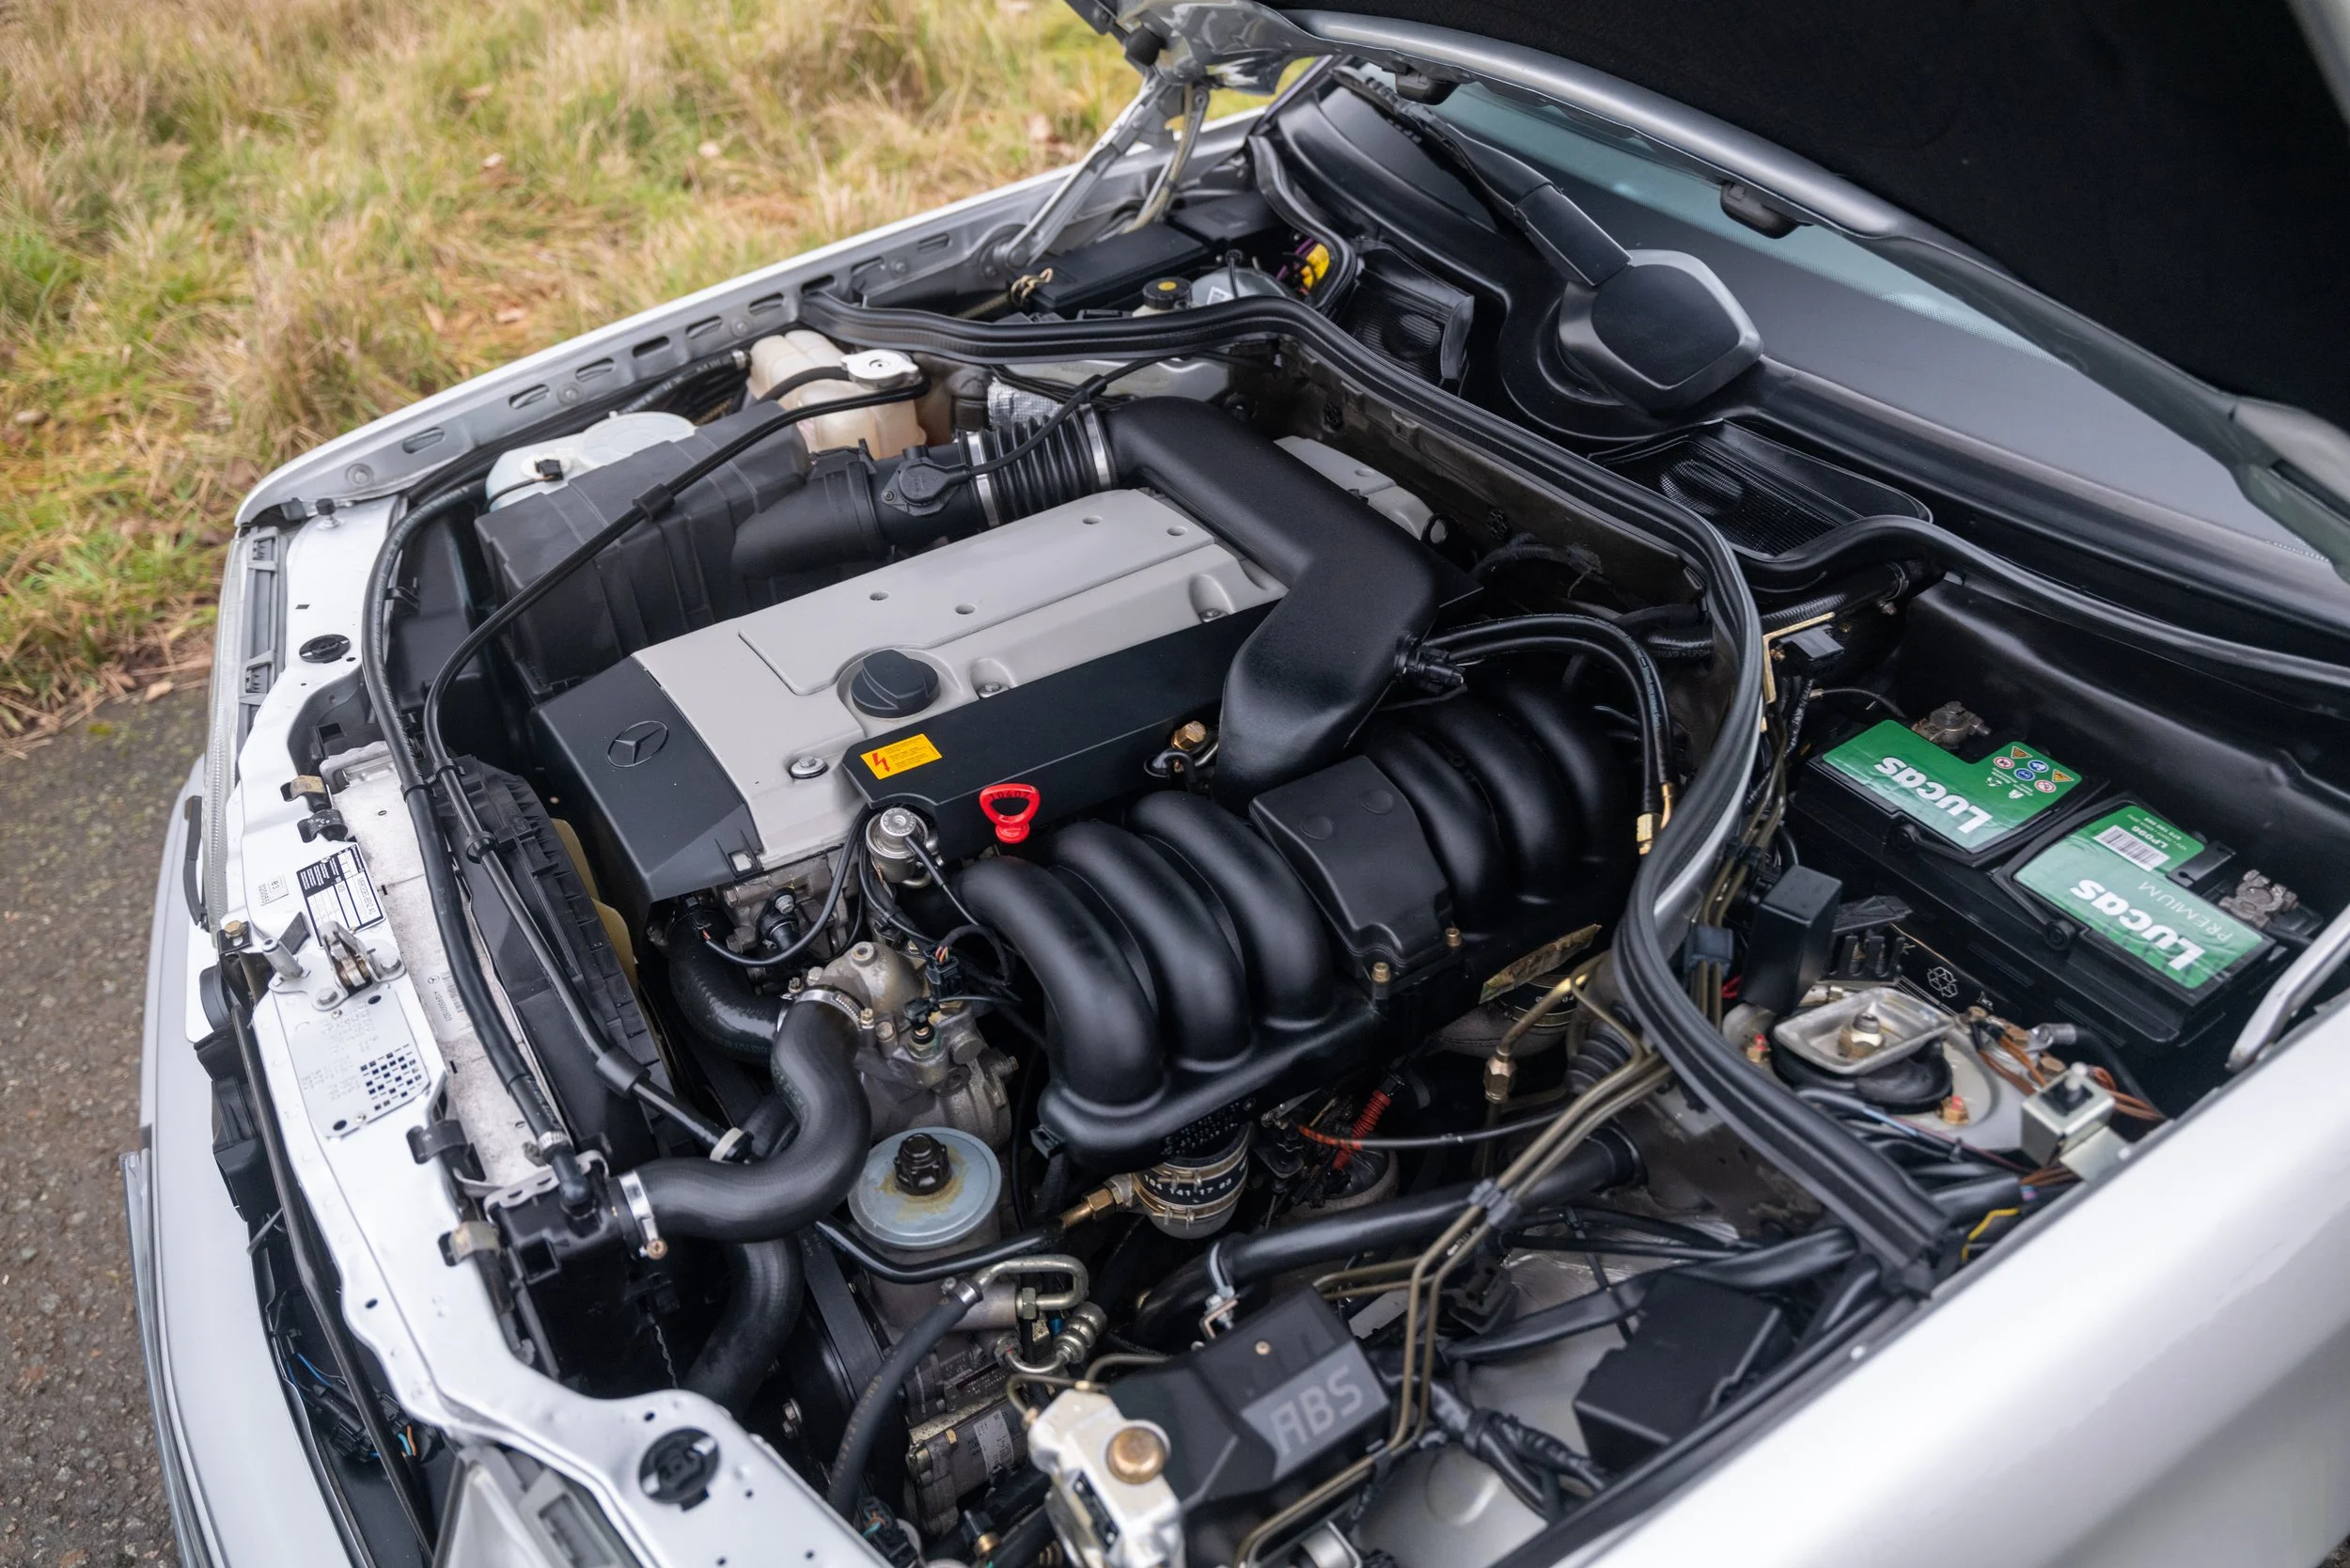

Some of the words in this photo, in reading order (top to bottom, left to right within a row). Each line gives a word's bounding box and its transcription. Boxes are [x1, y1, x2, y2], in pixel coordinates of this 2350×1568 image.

[1873, 757, 1993, 834] Lucas
[2131, 825, 2169, 849] LP096
[2070, 879, 2206, 971] Lucas
[2138, 881, 2233, 941] PREMIUM
[1144, 1174, 1163, 1190] 104
[1169, 1187, 1191, 1197] 141
[1198, 1186, 1214, 1196] 17
[1269, 1364, 1363, 1455] ABS
